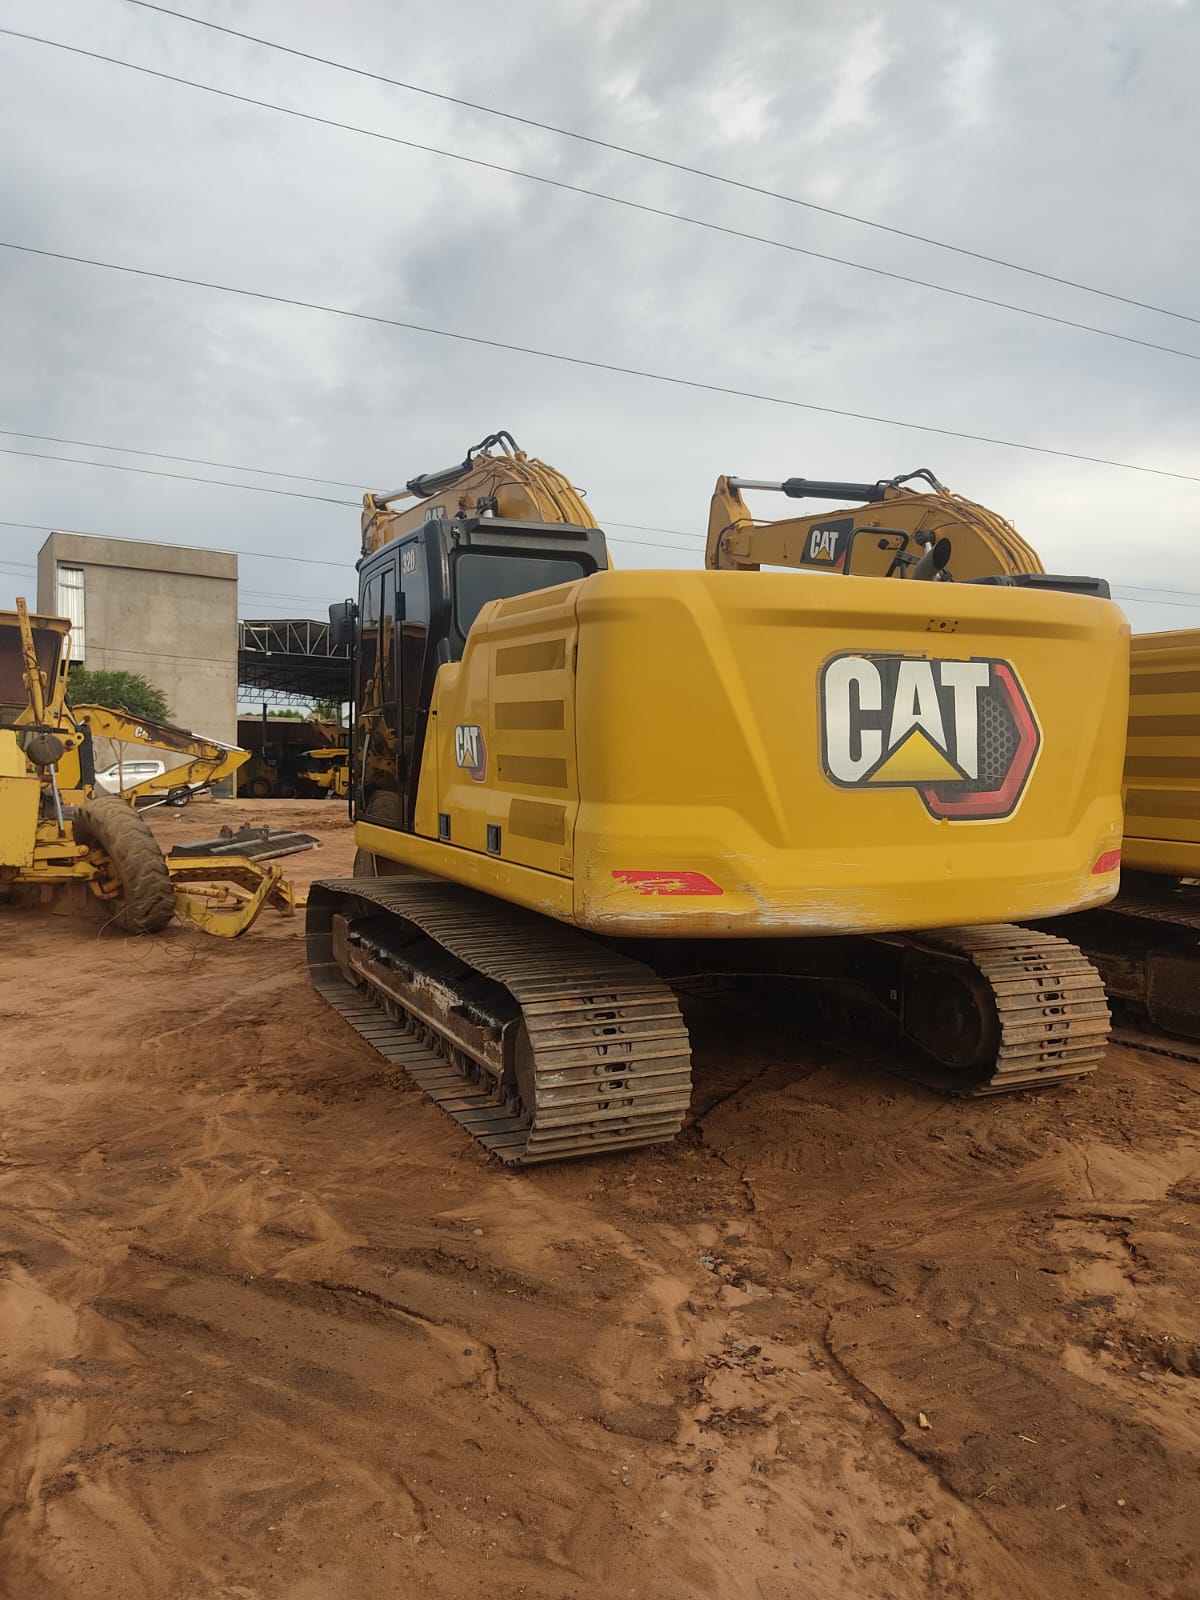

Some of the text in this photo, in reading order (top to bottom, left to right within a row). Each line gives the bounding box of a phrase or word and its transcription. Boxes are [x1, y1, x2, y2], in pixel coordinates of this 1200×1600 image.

[402, 549, 415, 574] 320
[810, 530, 839, 561] CAT
[825, 657, 990, 782] CAT
[455, 726, 479, 768] CAT
